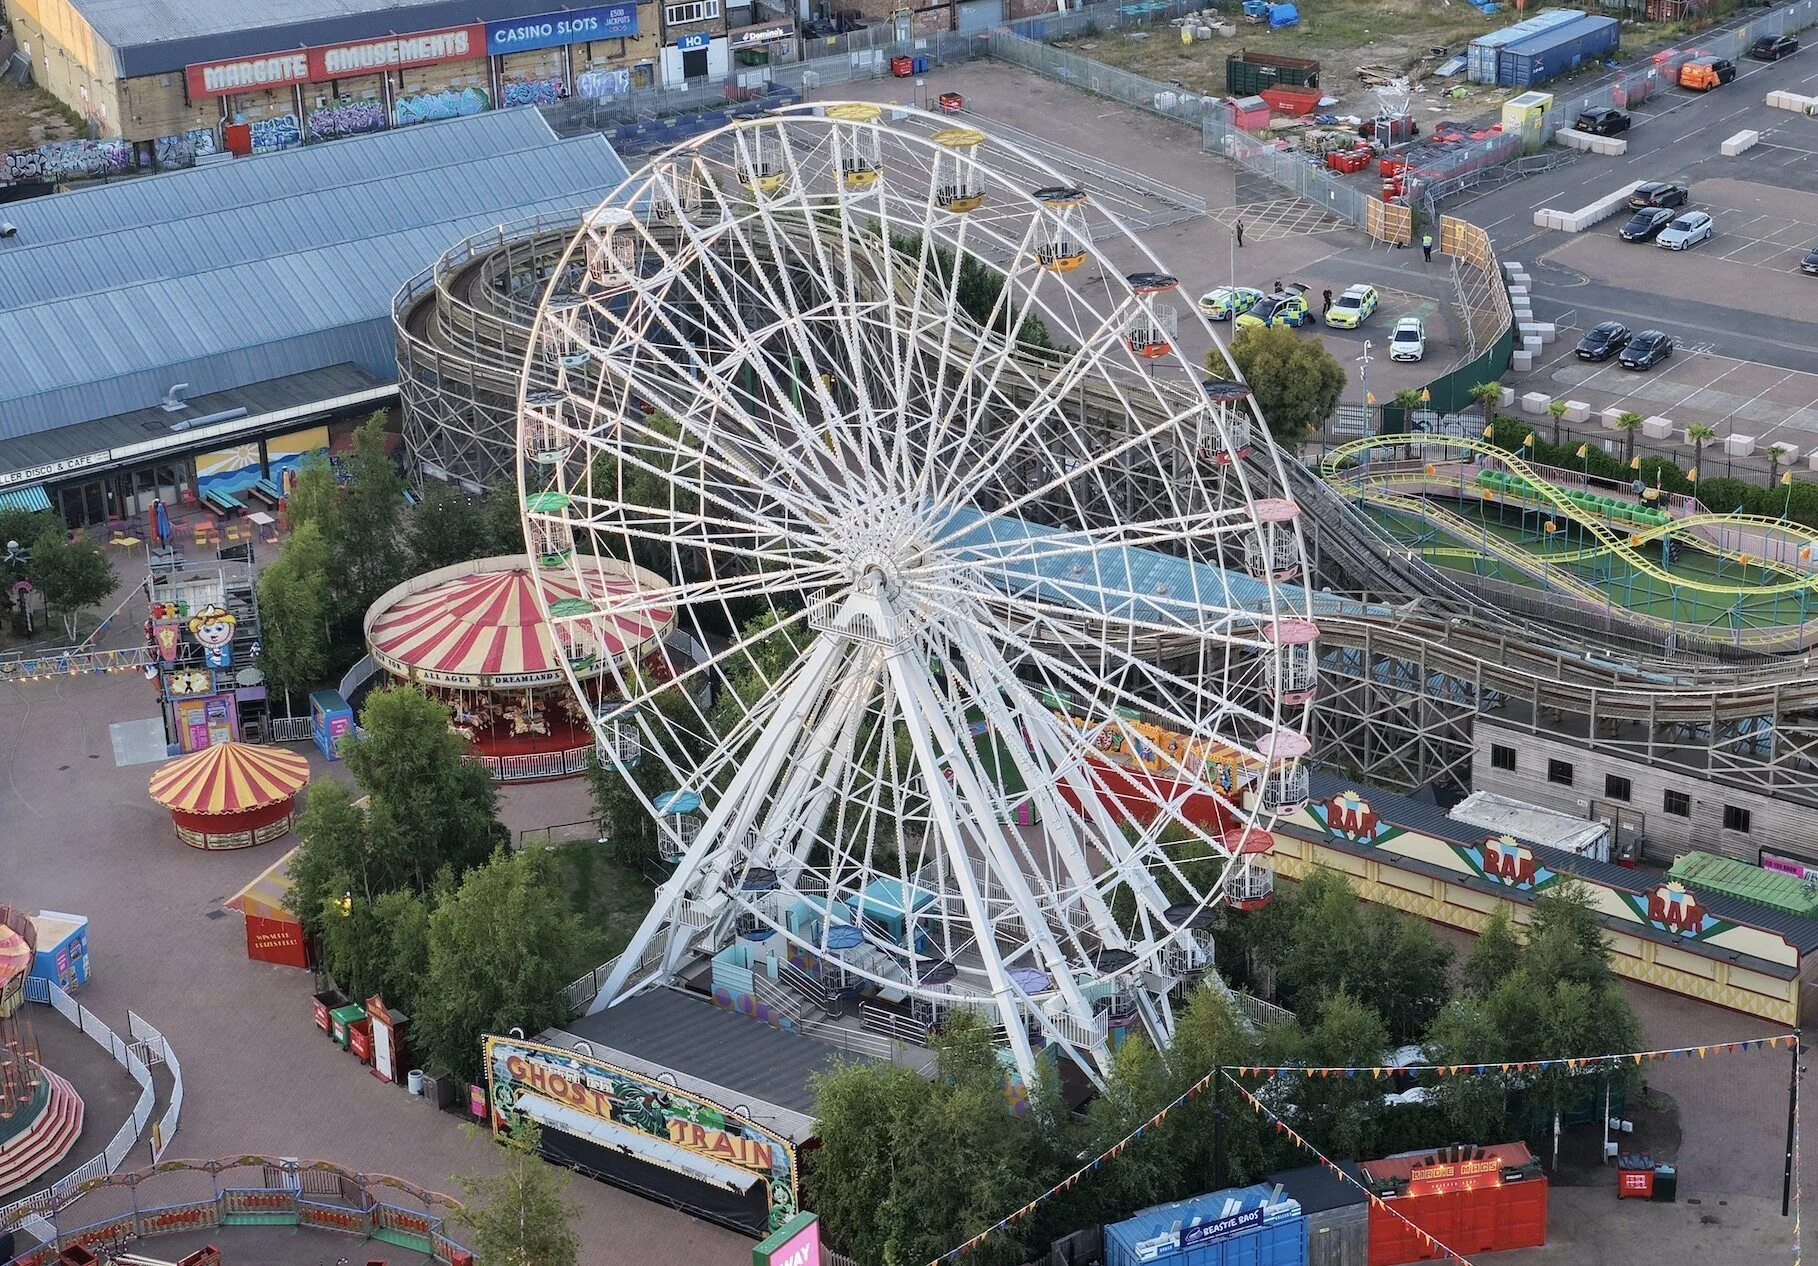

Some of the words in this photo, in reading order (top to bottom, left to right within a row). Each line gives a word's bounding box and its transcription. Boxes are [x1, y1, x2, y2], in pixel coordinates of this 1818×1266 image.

[495, 24, 552, 43] CASINO
[556, 17, 598, 34] SLOTS
[605, 16, 631, 26] JACKPOTS
[749, 28, 784, 40] Domino's
[685, 35, 702, 48] HQ
[203, 54, 307, 92] MARGATE
[324, 30, 469, 73] AMUSEMENTS
[26, 465, 52, 478] DISCO
[57, 463, 64, 471] &
[68, 456, 92, 469] CAFE
[589, 655, 624, 671] FAMUS
[424, 671, 440, 680] ALL
[445, 675, 471, 684] AGES
[1327, 807, 1377, 840] BAR
[1483, 849, 1536, 886] BAR
[1648, 895, 1703, 934] BAR
[507, 1055, 609, 1117] GHOST
[668, 1119, 773, 1169] TRAIN
[1202, 1221, 1238, 1236] BEASTIE
[1238, 1210, 1260, 1224] BAOS
